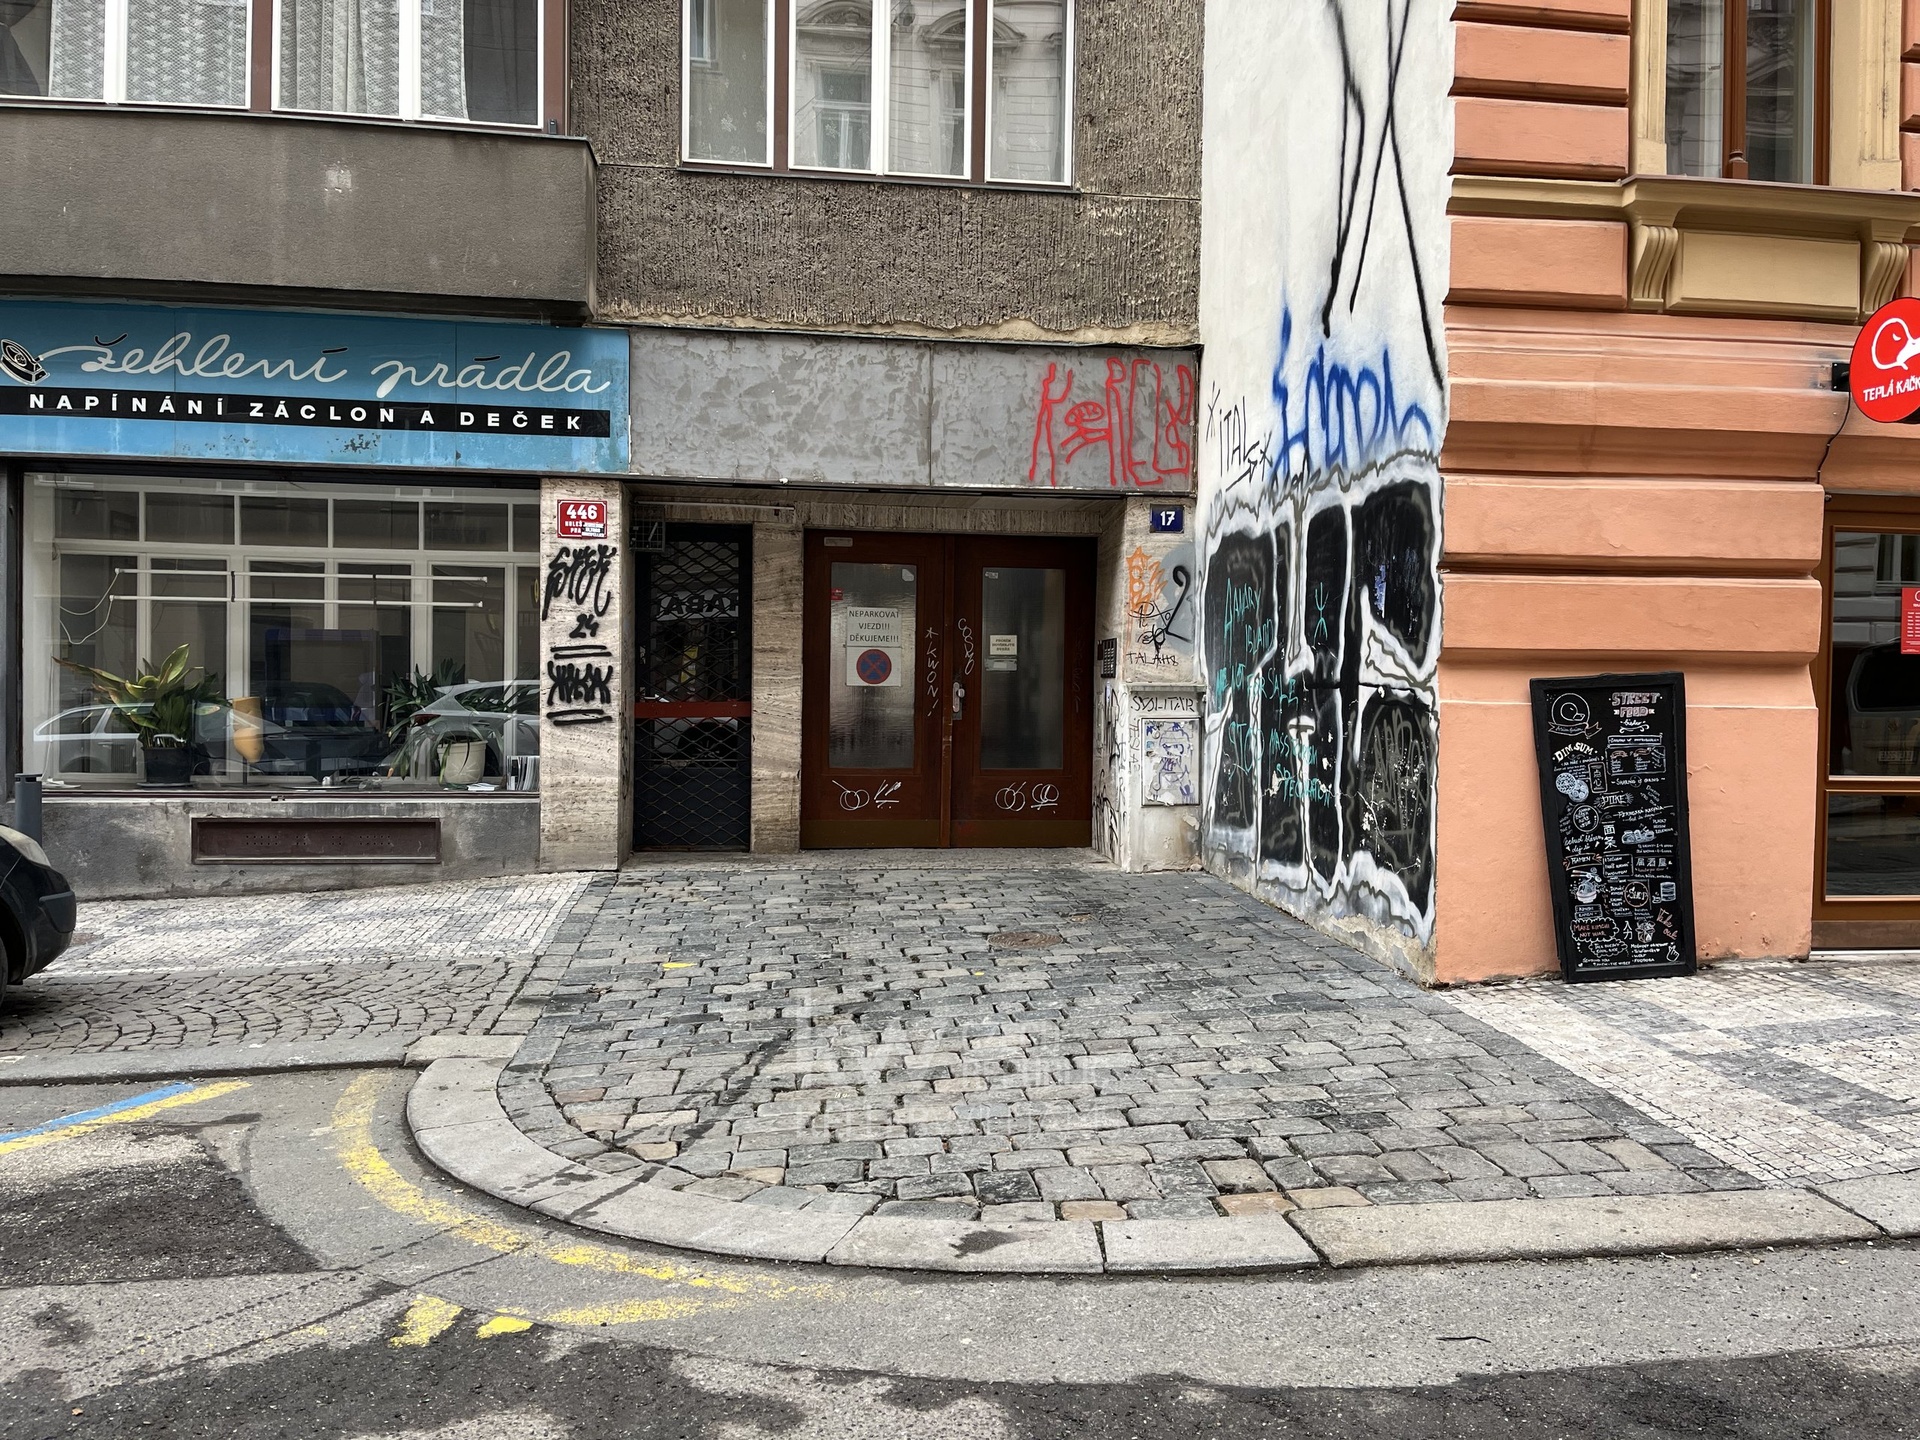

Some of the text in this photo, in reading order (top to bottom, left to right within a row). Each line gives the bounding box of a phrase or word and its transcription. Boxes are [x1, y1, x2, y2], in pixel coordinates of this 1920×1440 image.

[81, 331, 347, 381] žehlení
[1863, 379, 1894, 402] TEPLÁ
[29, 393, 583, 431] NAPÍNÁNÍ ZÁCLON A DEČEK
[566, 503, 598, 520] 446
[1160, 511, 1175, 526] 17
[849, 633, 899, 643] DĚKUJEME!!!
[1611, 691, 1661, 706] STREET
[1620, 706, 1649, 718] FOOD
[1554, 742, 1594, 763] DIM SUM
